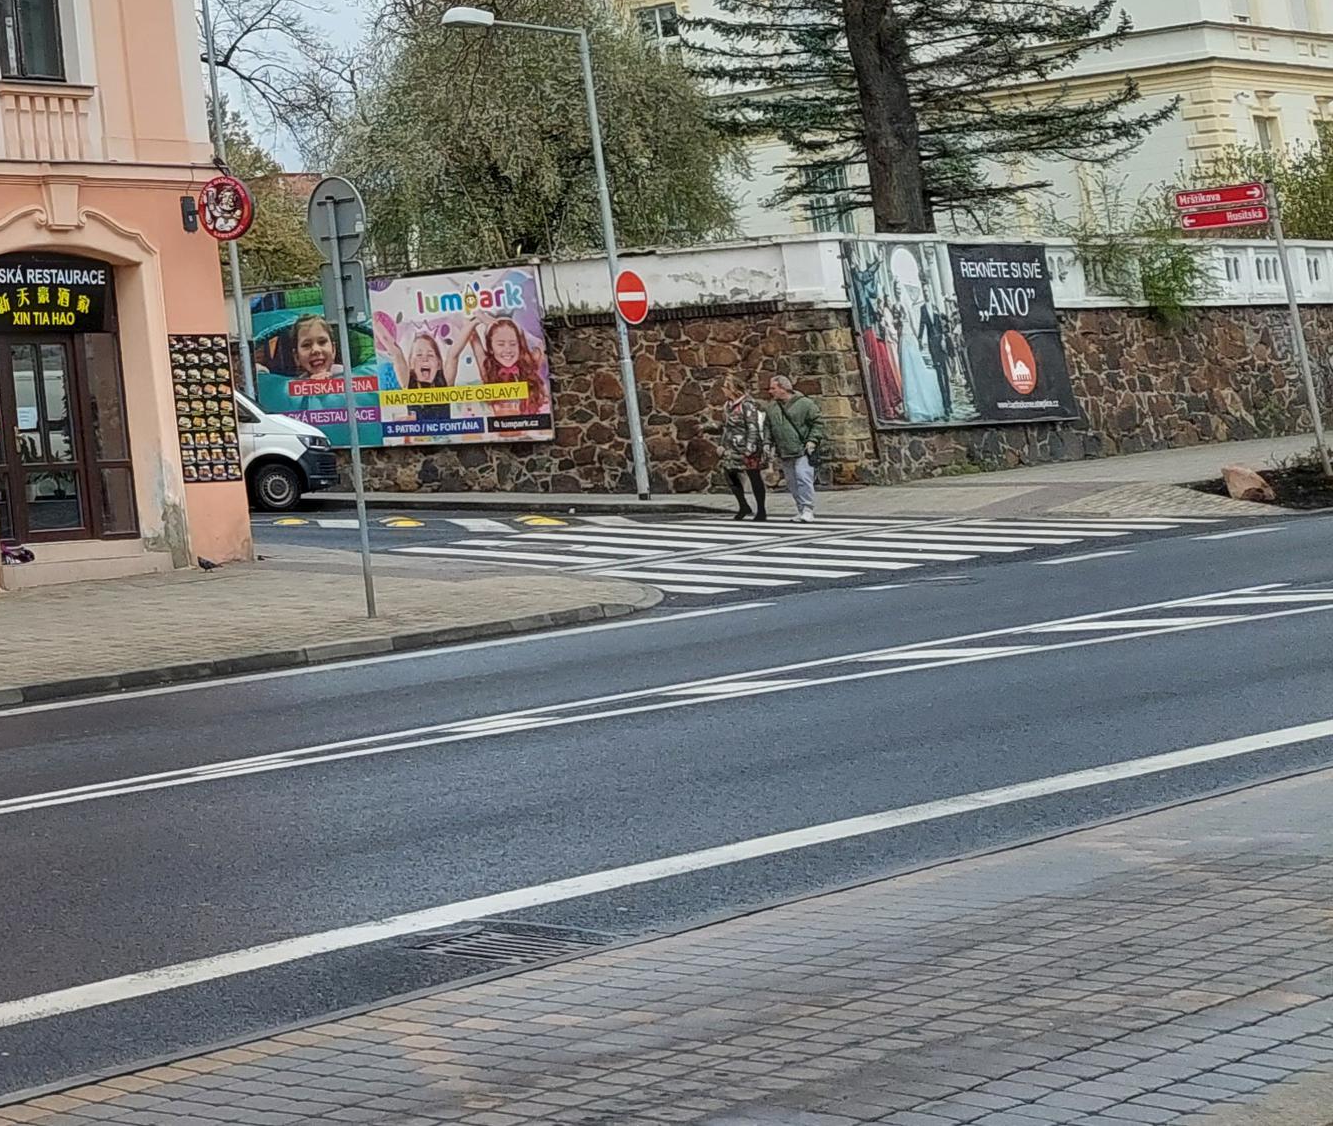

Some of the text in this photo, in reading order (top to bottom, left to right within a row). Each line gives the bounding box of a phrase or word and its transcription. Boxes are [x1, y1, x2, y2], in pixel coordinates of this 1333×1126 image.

[960, 257, 1043, 278] ŘEKNĚTE SI SVÉ
[26, 268, 106, 285] RESTAURACE
[417, 282, 523, 315] lumpark
[13, 312, 75, 325] XIN TIA HAO
[294, 380, 373, 395] DĚTSKÁ HRNA
[386, 386, 520, 405] NAROZENINOVÉ OSLAVY
[310, 410, 376, 424] RESTAUACE
[395, 424, 421, 434] PATRO
[440, 420, 479, 432] FONTÁNA
